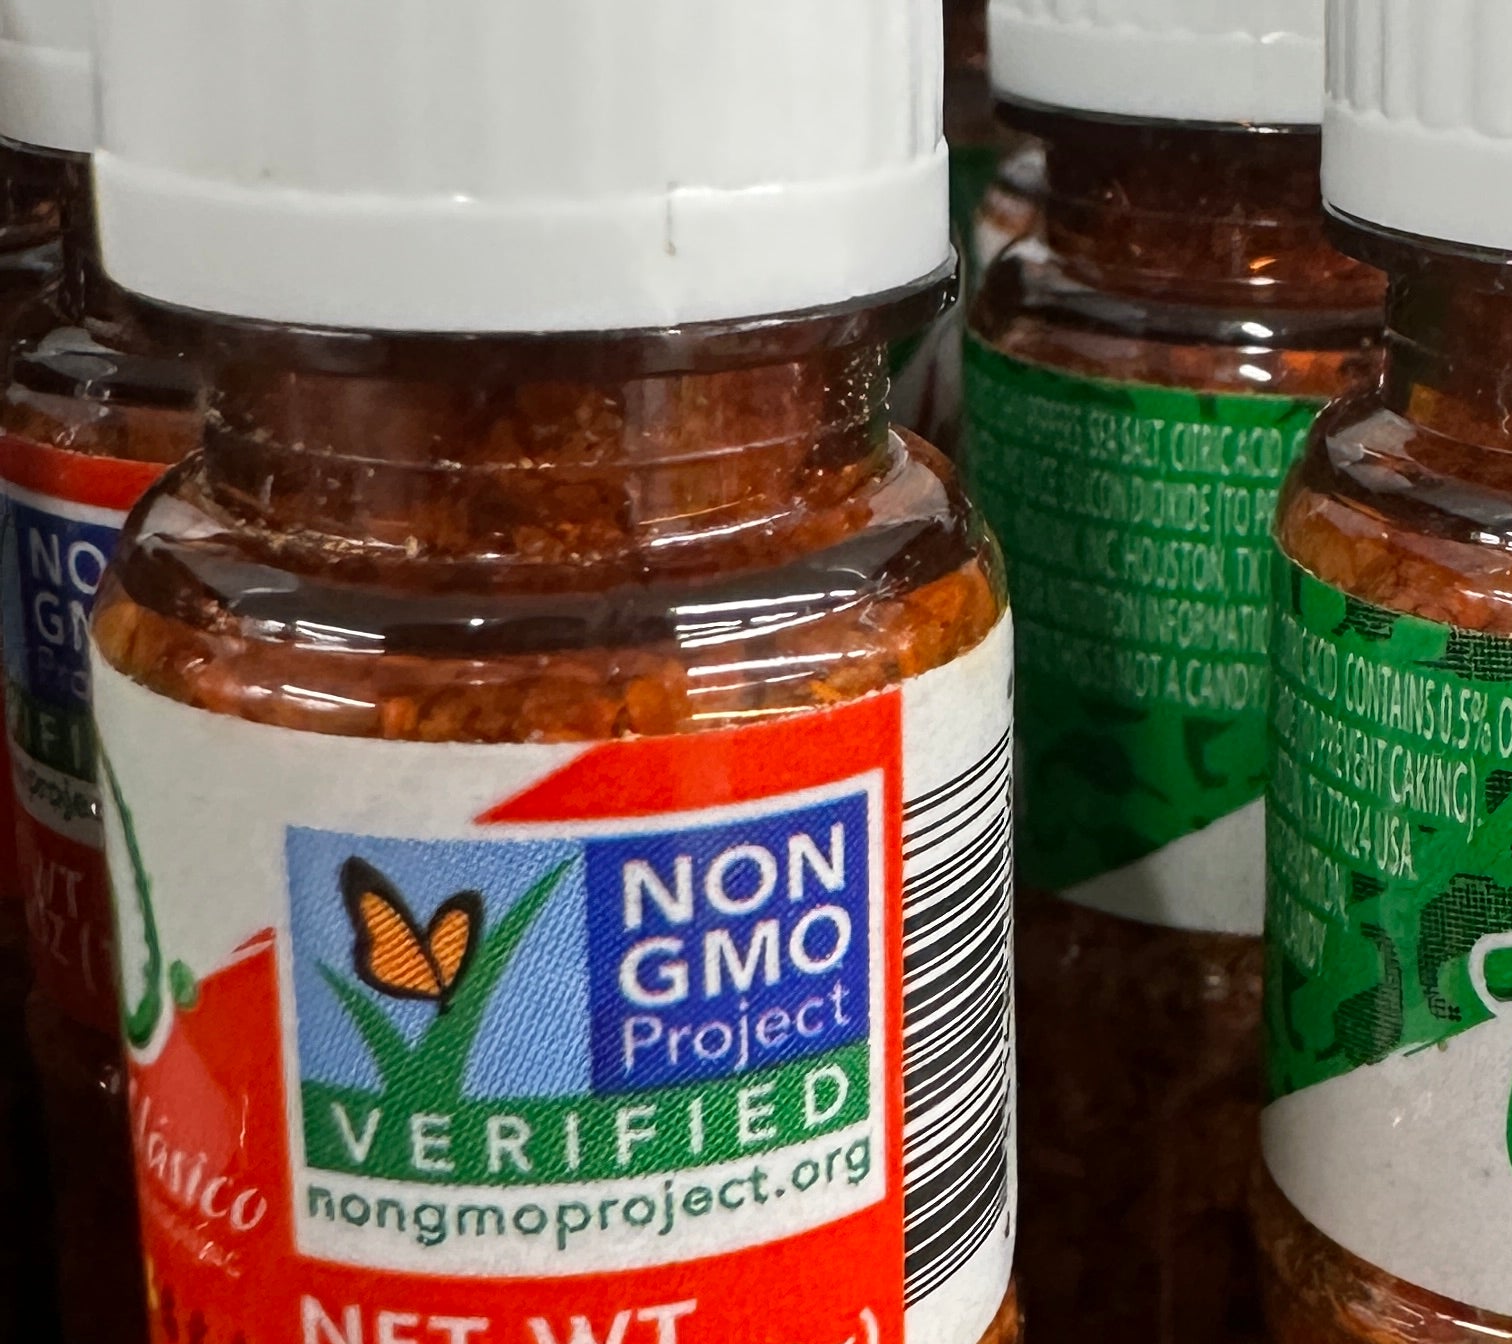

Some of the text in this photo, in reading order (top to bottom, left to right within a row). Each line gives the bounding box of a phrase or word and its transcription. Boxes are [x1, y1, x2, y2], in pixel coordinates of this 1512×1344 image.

[29, 526, 106, 595] NO
[1345, 652, 1436, 741] CONTAINS
[1440, 682, 1493, 756] 0.5%
[622, 821, 846, 933] NON
[1374, 809, 1419, 882] USA
[618, 903, 852, 1008] GMO
[621, 979, 852, 1080] Project
[330, 1063, 850, 1173] VERIFIED
[307, 1134, 872, 1250] nongmoproject.org
